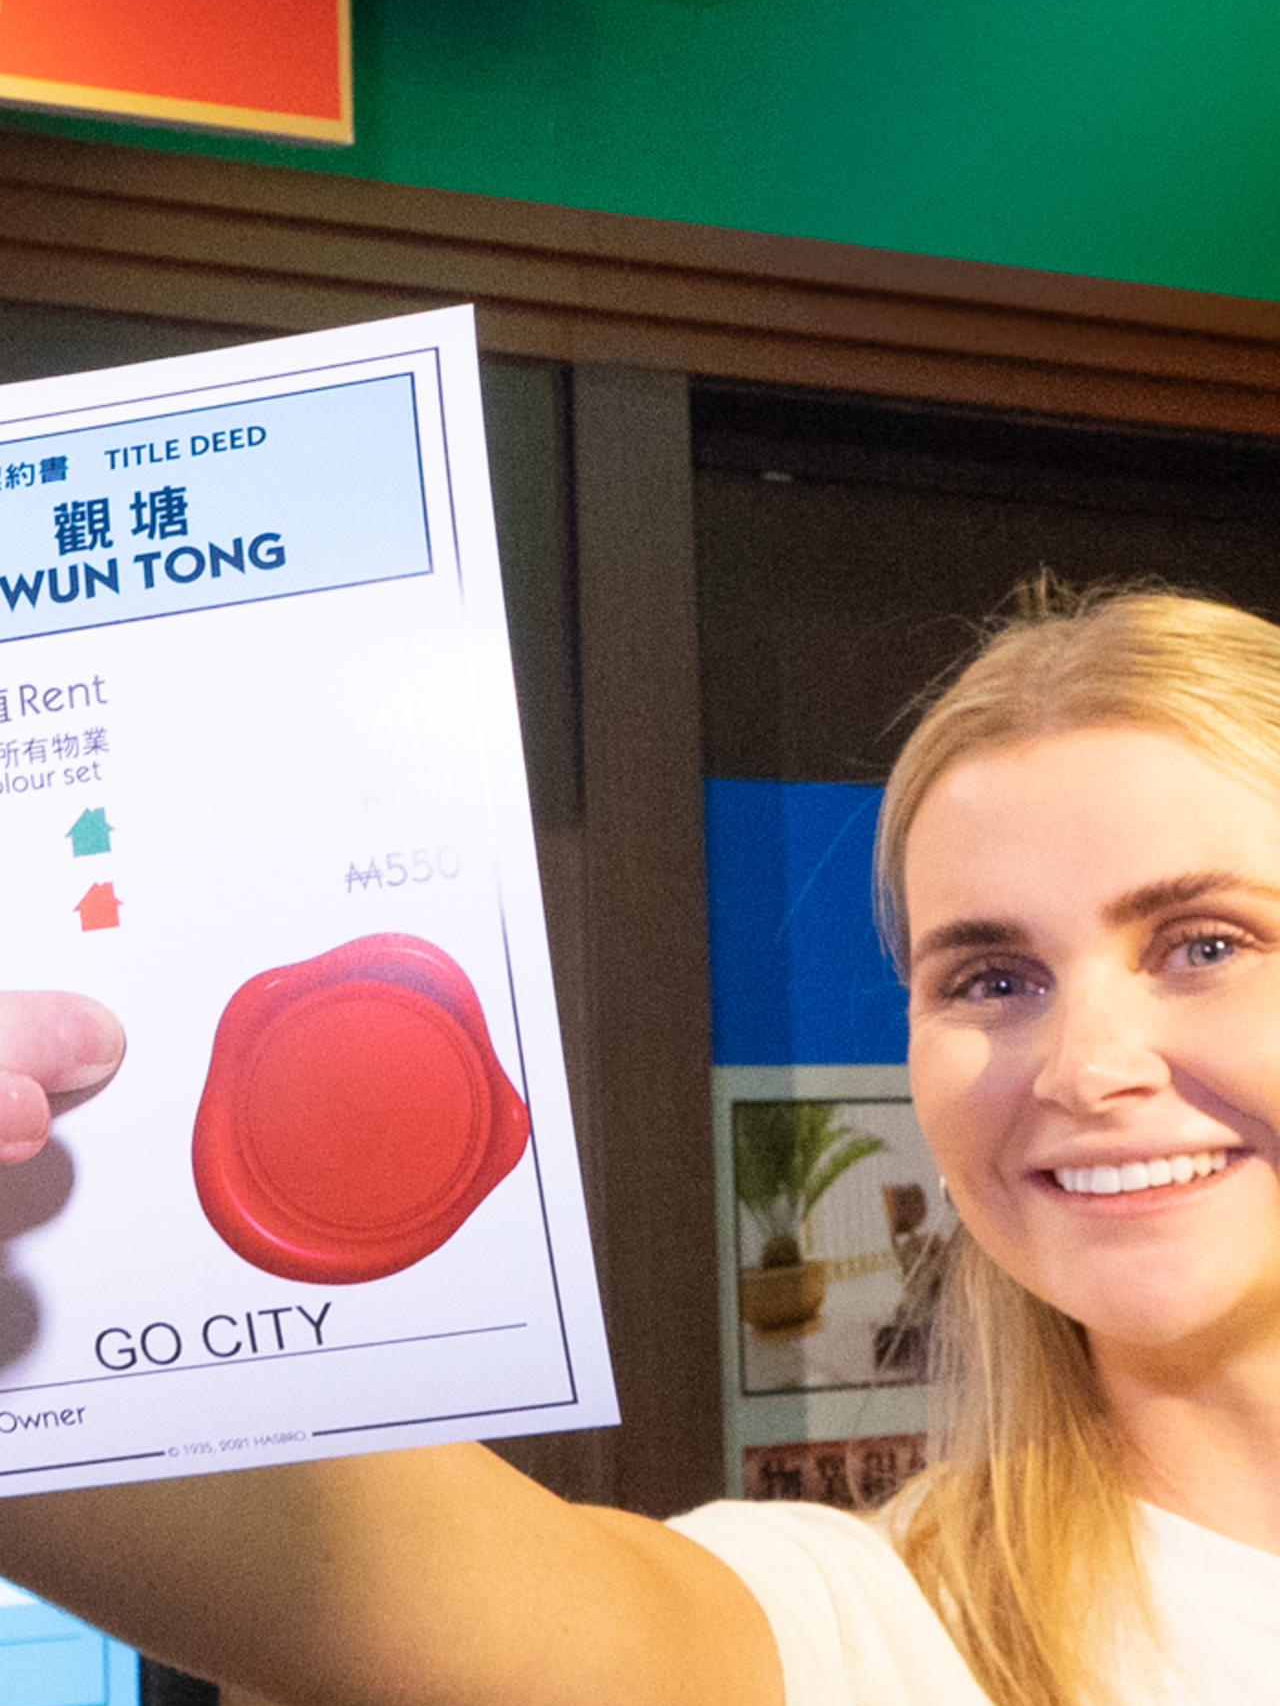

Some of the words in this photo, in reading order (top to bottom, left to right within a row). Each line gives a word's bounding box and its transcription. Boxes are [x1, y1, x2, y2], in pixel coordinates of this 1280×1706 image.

[104, 438, 181, 471] TITLE
[189, 425, 267, 457] DEED
[53, 484, 190, 556] 觀塘
[133, 531, 287, 590] TONG
[63, 760, 103, 787] set
[93, 1321, 182, 1372] GO
[201, 1301, 333, 1359] CITY
